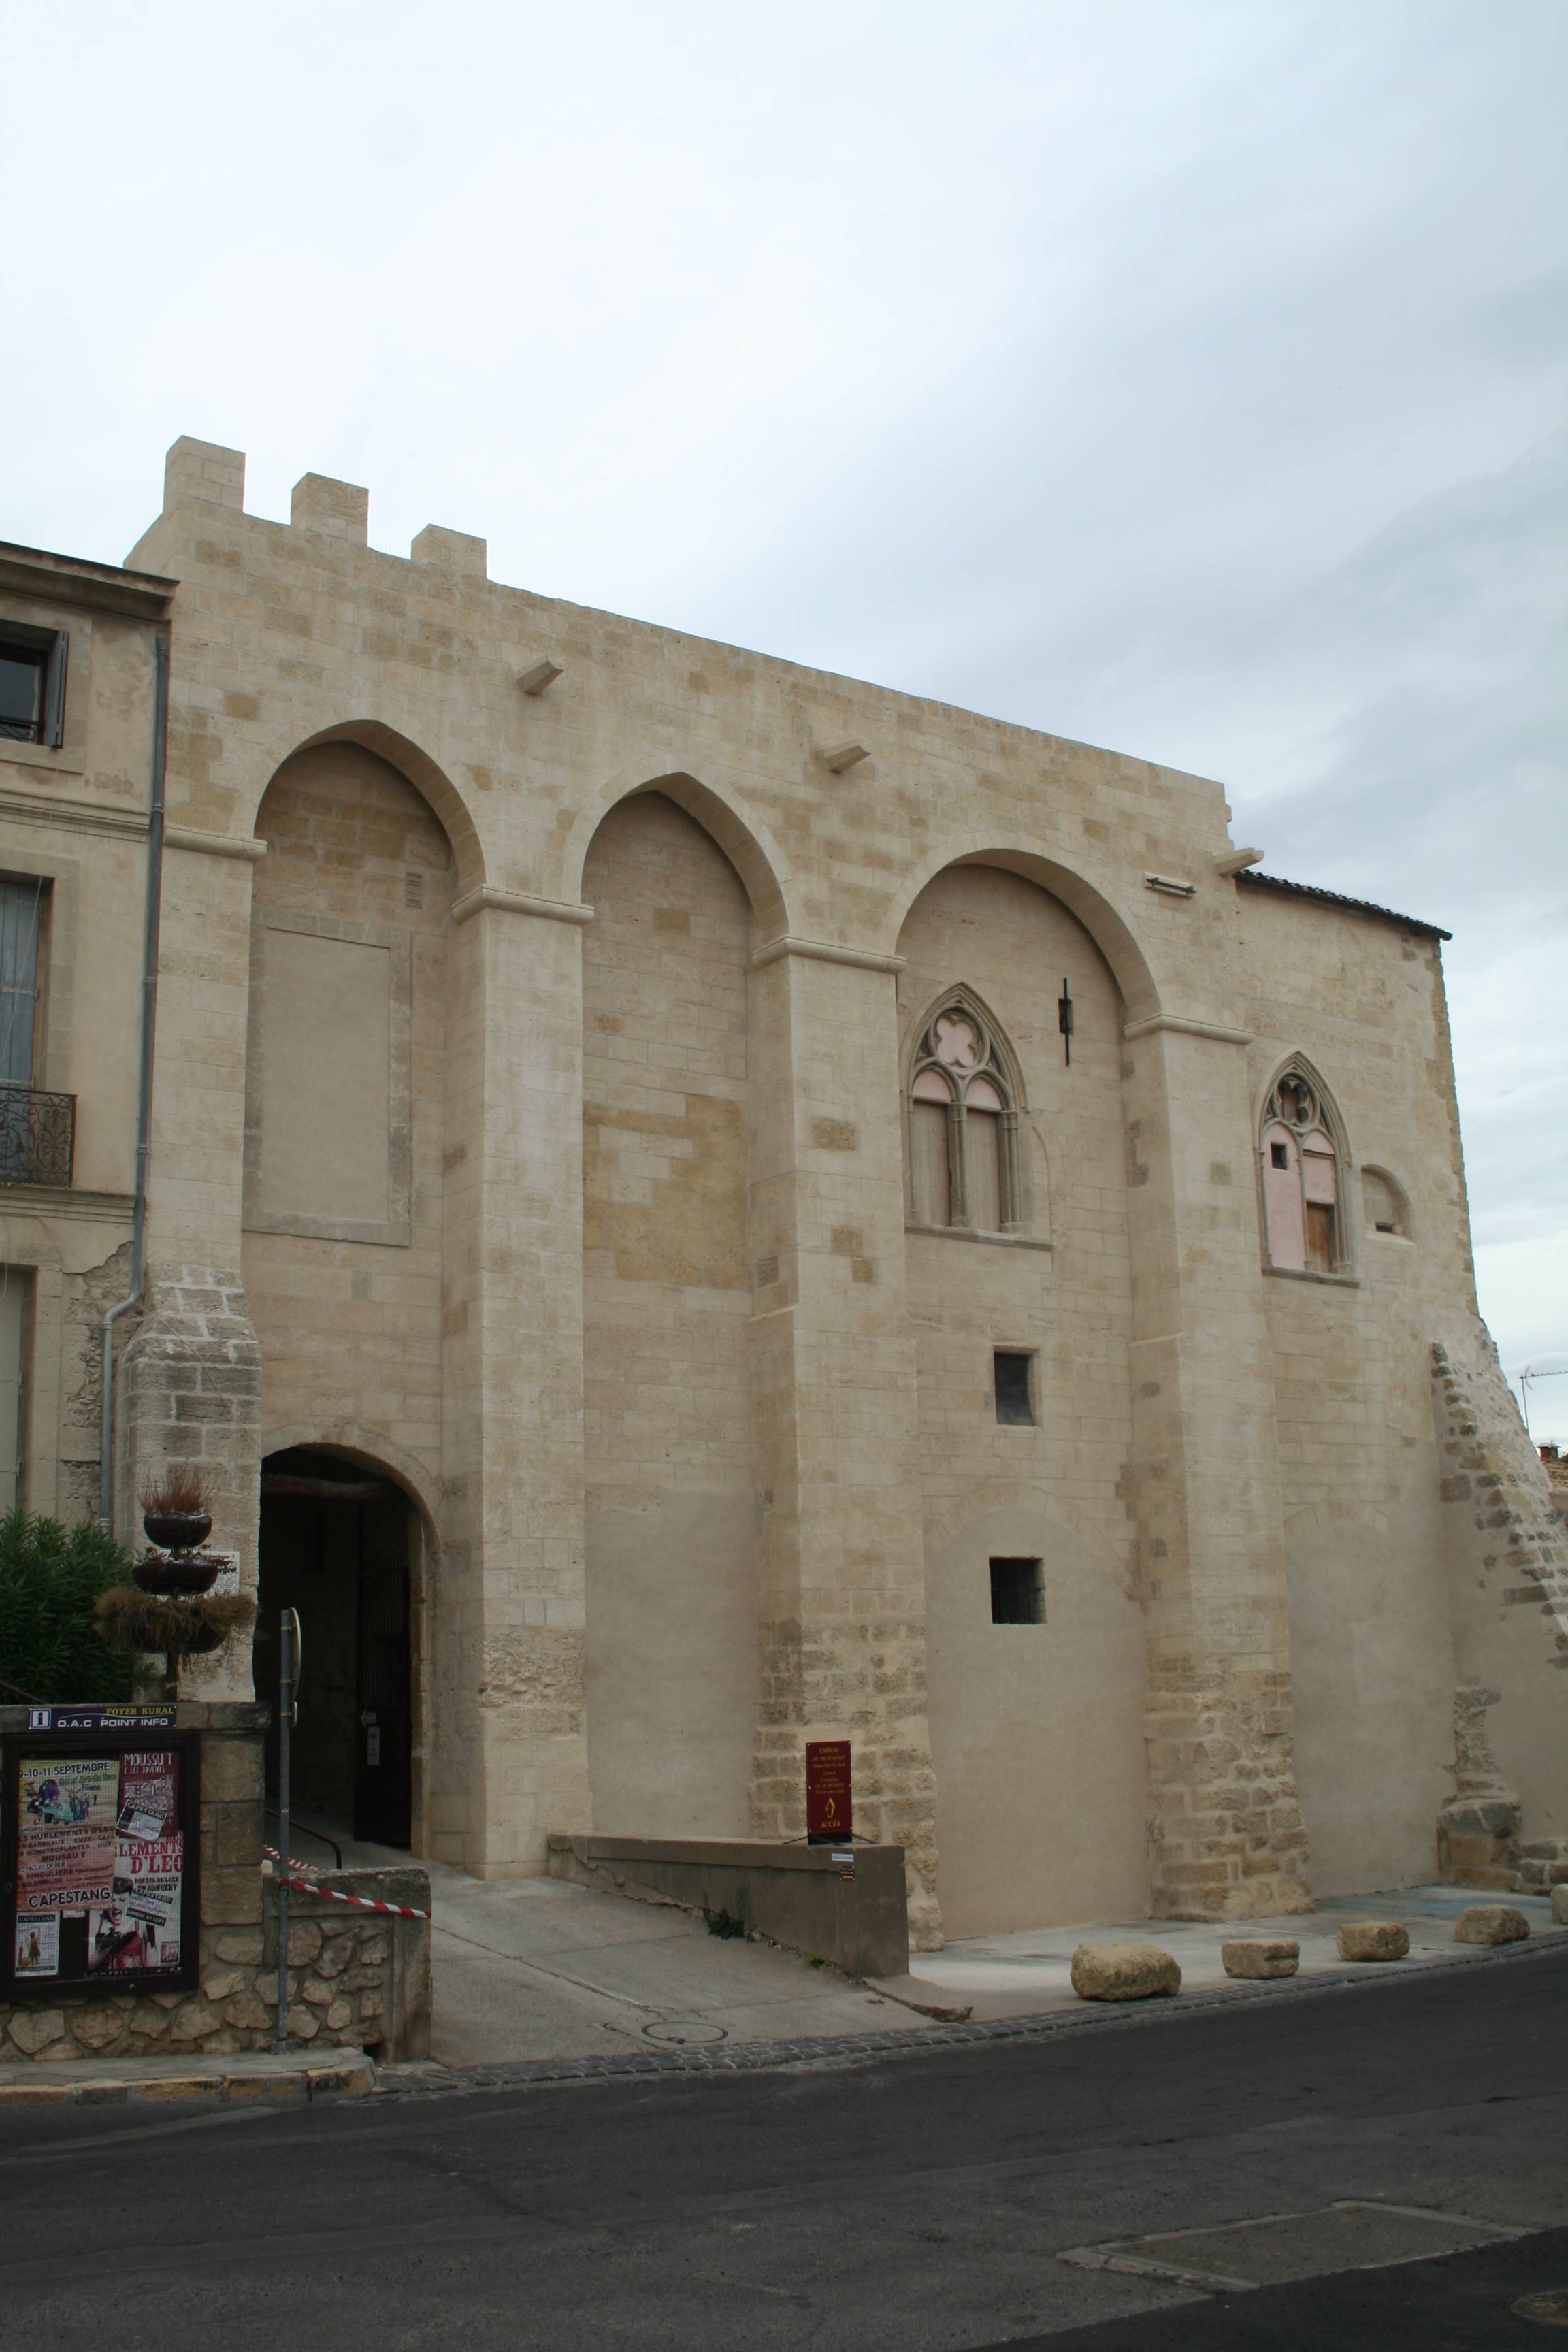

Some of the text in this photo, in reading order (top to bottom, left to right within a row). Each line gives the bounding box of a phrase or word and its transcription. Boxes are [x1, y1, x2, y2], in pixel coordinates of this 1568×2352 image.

[142, 1707, 174, 1715] RURAL
[101, 1718, 136, 1727] POINT
[141, 1718, 168, 1726] INFO
[124, 1752, 174, 1766] MOUSSU T
[54, 1762, 110, 1775] SEPTEMBRE
[127, 1801, 165, 1819] CAPESTANG
[31, 1828, 88, 1840] HURLEMENTS
[91, 1826, 115, 1834] D'LEO
[115, 1839, 184, 1857] LEMENTS
[42, 1852, 78, 1862] MOUSSU
[131, 1854, 184, 1874] D'LEO
[147, 1884, 178, 1892] CONCERT
[29, 1886, 111, 1908] CAPESTANG
